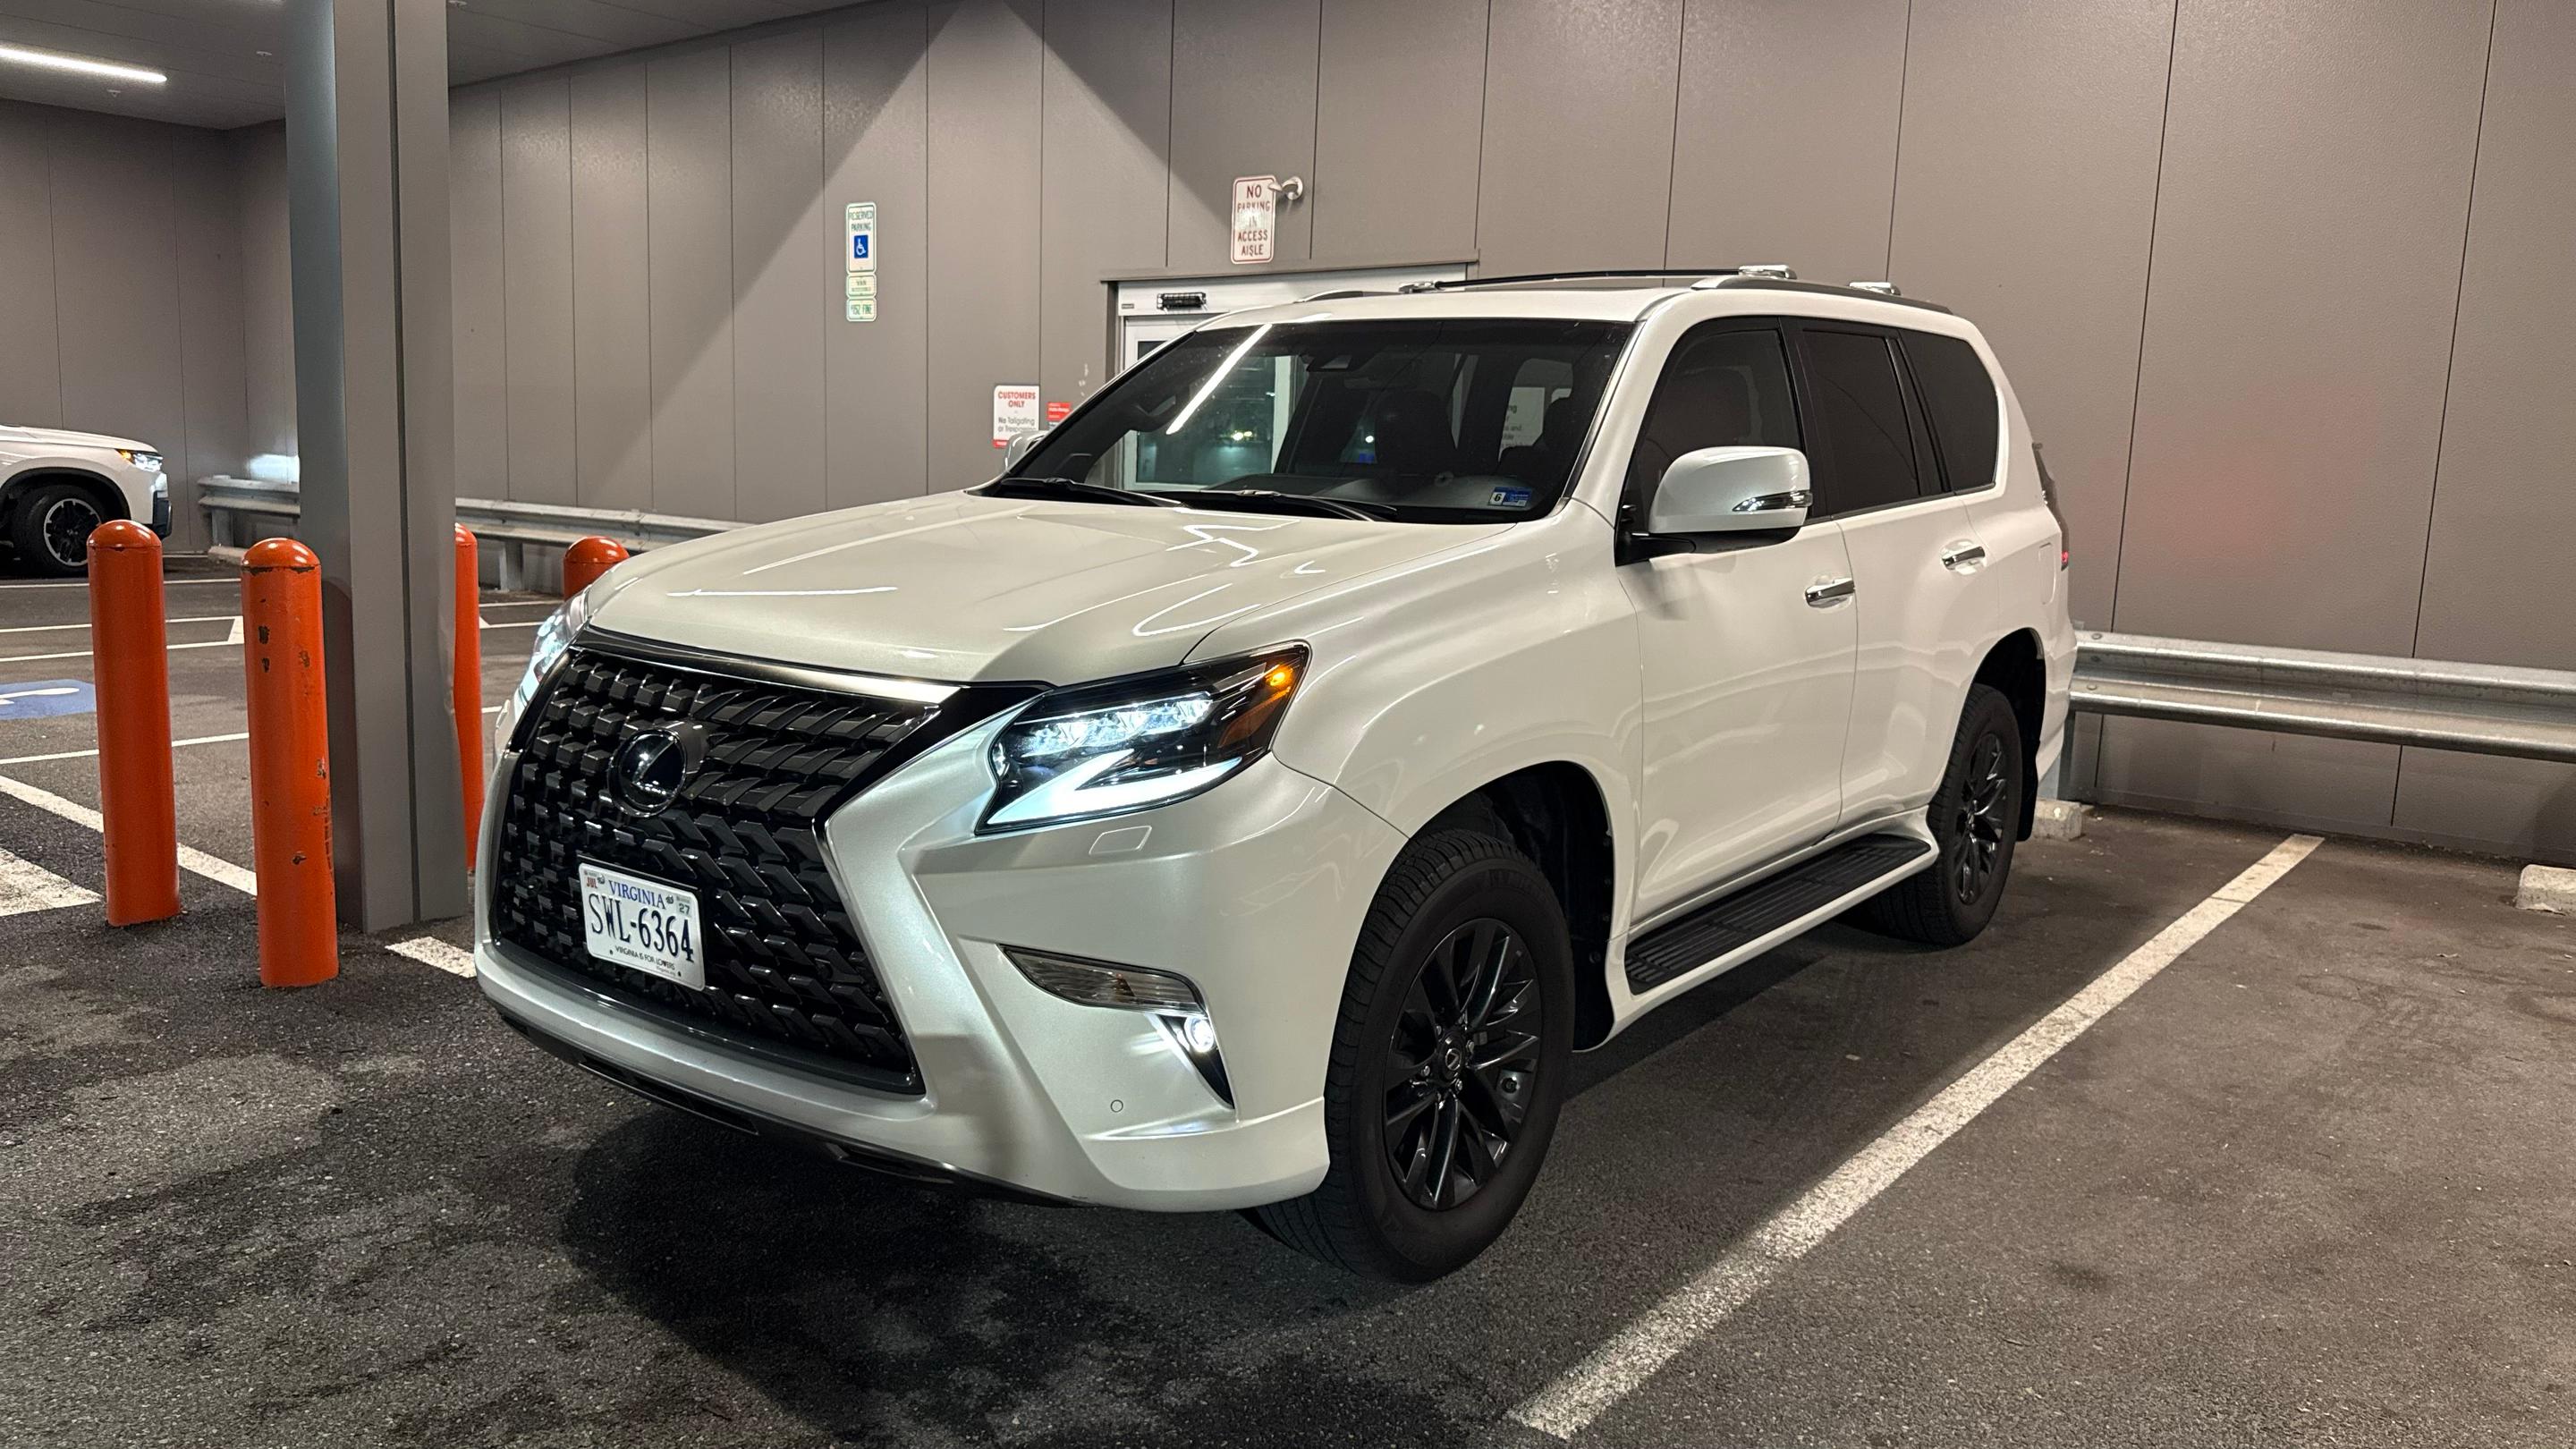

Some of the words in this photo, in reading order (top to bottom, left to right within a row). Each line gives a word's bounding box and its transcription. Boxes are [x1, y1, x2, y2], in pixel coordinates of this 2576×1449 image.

[1246, 185, 1262, 199] NO
[1237, 201, 1270, 213] PARKING
[848, 210, 874, 221] RESERVED
[851, 222, 871, 232] PARKING
[1237, 230, 1268, 242] ACCESS
[1241, 244, 1263, 257] AISLE
[998, 392, 1036, 400] CUSTOMERS
[1008, 400, 1025, 408] ONLY
[1008, 417, 1035, 427] Tailgating
[1494, 494, 1502, 502] 6
[586, 877, 597, 889] JUL
[608, 879, 666, 910] VIRGINIA
[679, 902, 690, 915] 27
[589, 893, 695, 963] SWL-6364
[614, 945, 639, 958] VIRGINIA
[644, 953, 655, 964] FOR
